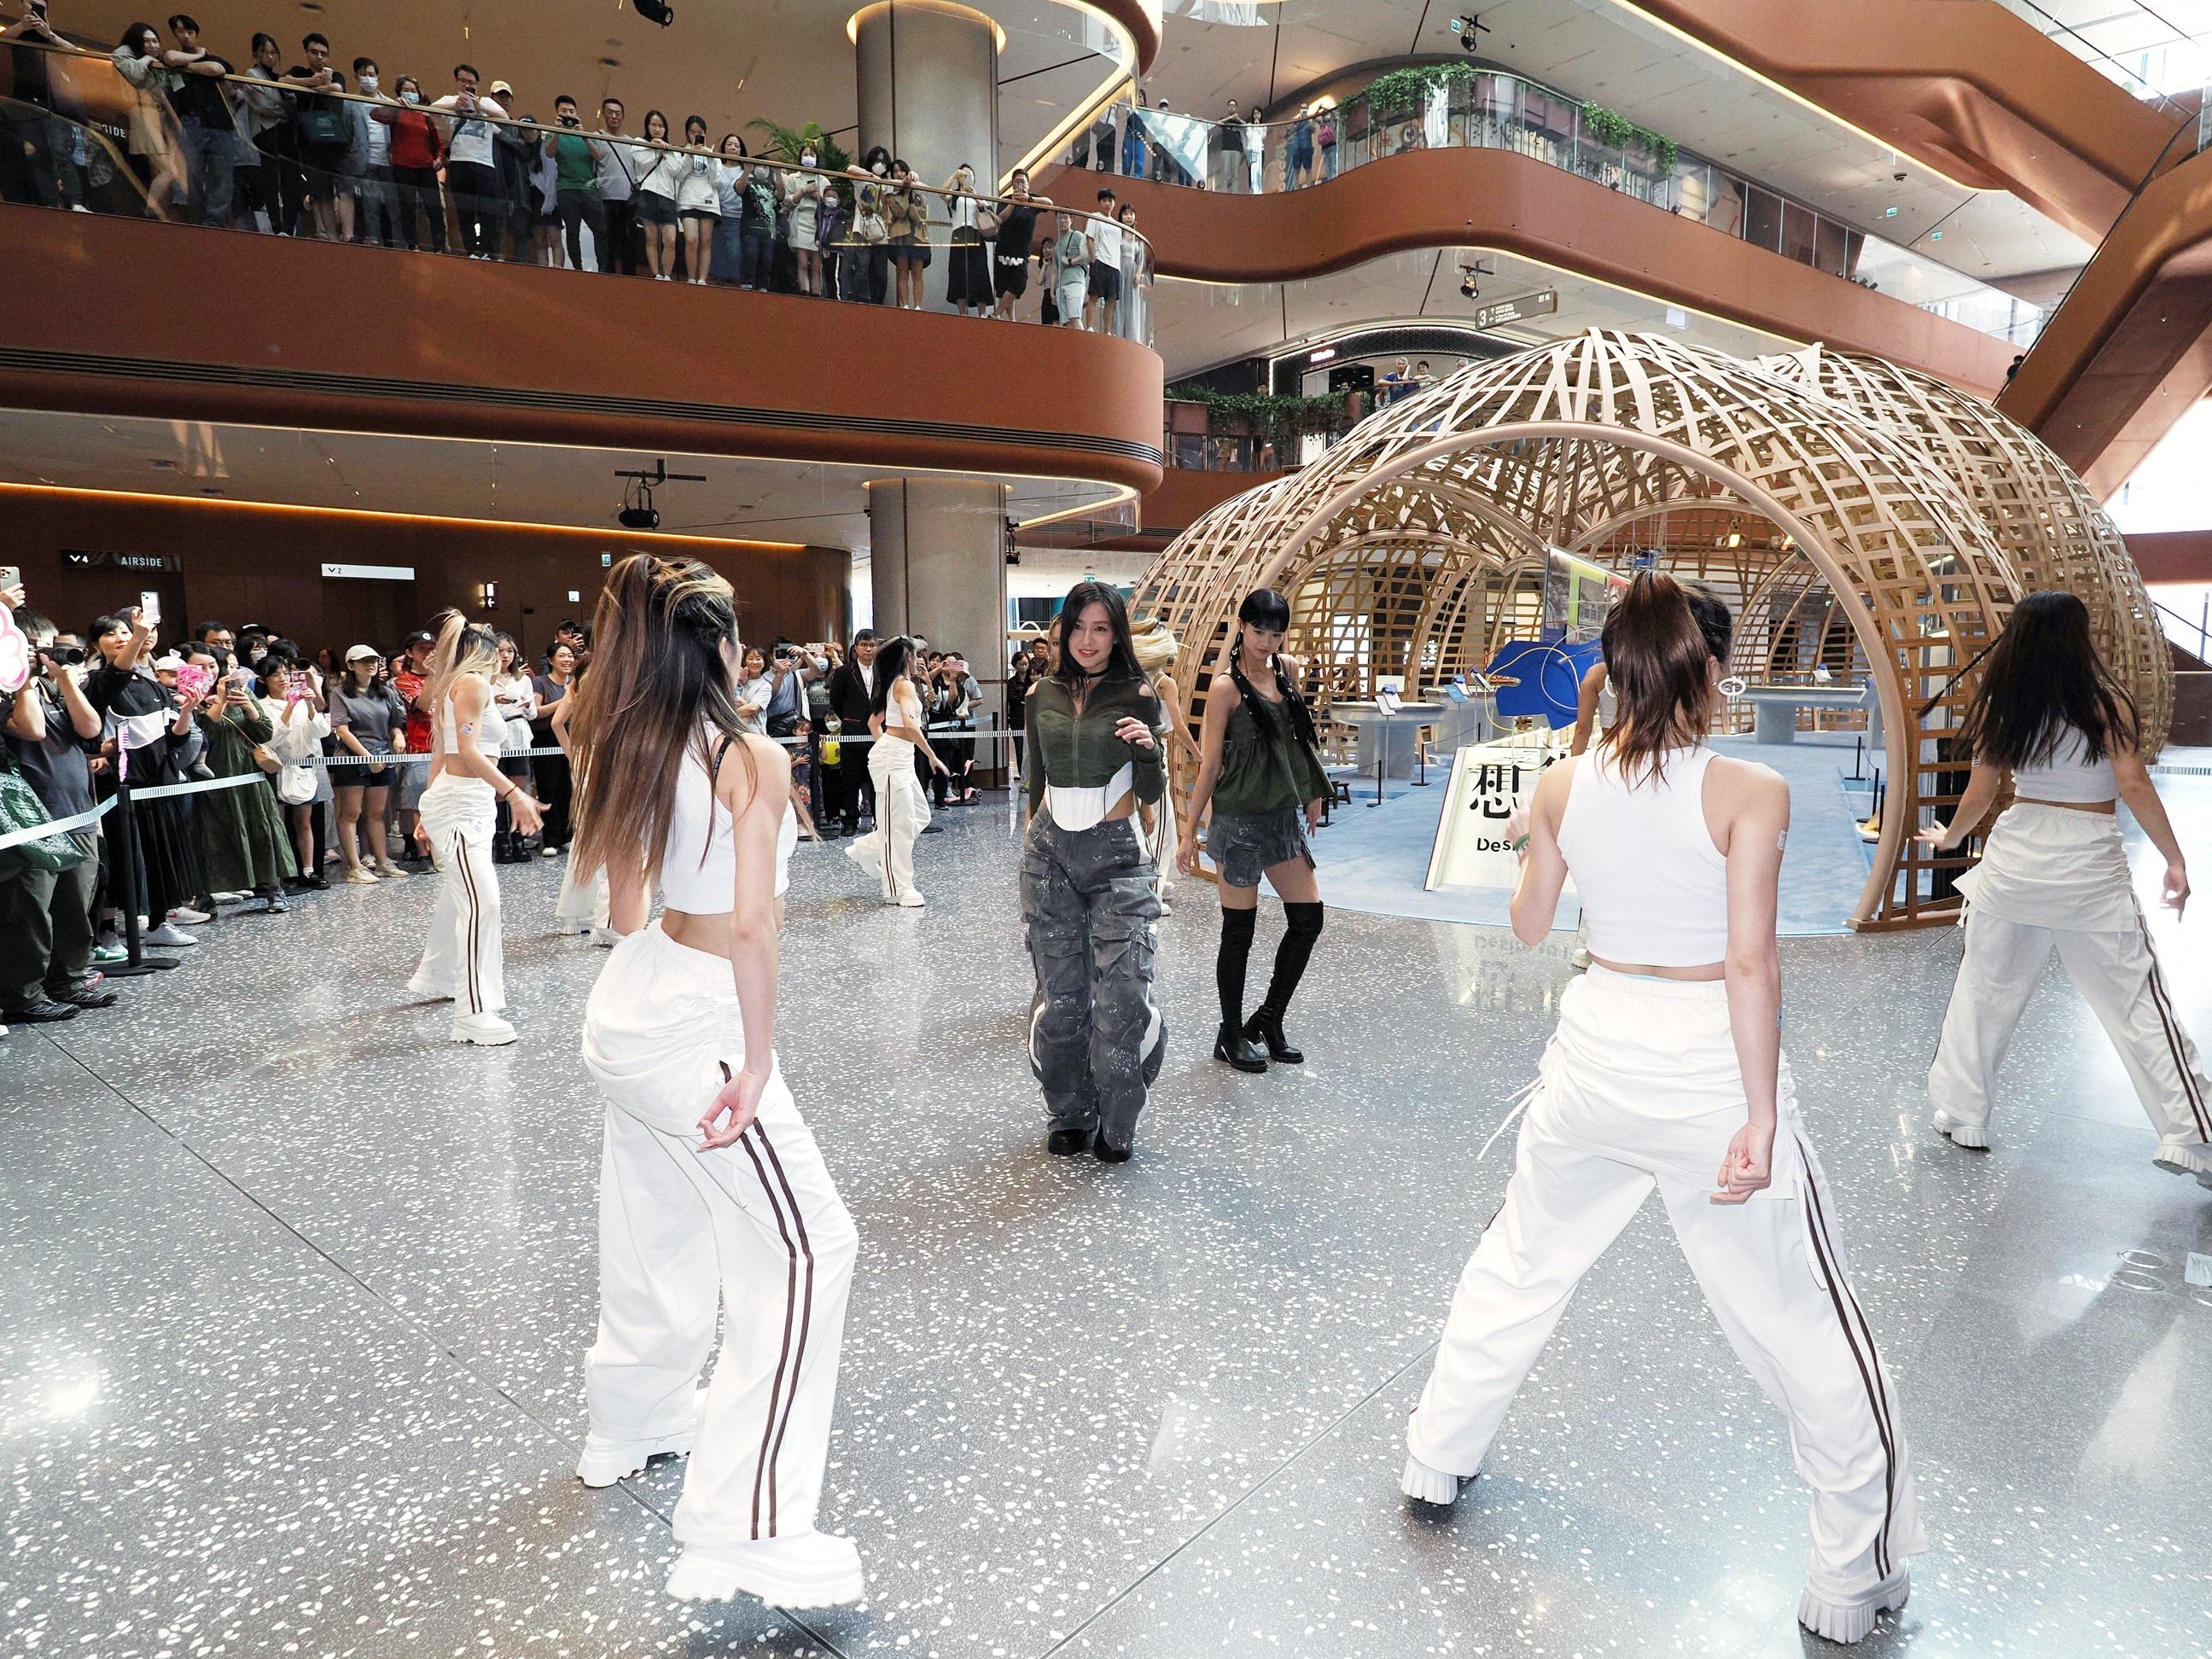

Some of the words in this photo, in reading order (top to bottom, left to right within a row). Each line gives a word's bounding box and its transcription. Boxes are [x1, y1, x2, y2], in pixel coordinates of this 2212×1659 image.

[102, 124, 126, 138] SIDE
[1479, 310, 1487, 326] 3
[121, 556, 162, 567] AIRSIDE
[2148, 765, 2172, 774] SIDE
